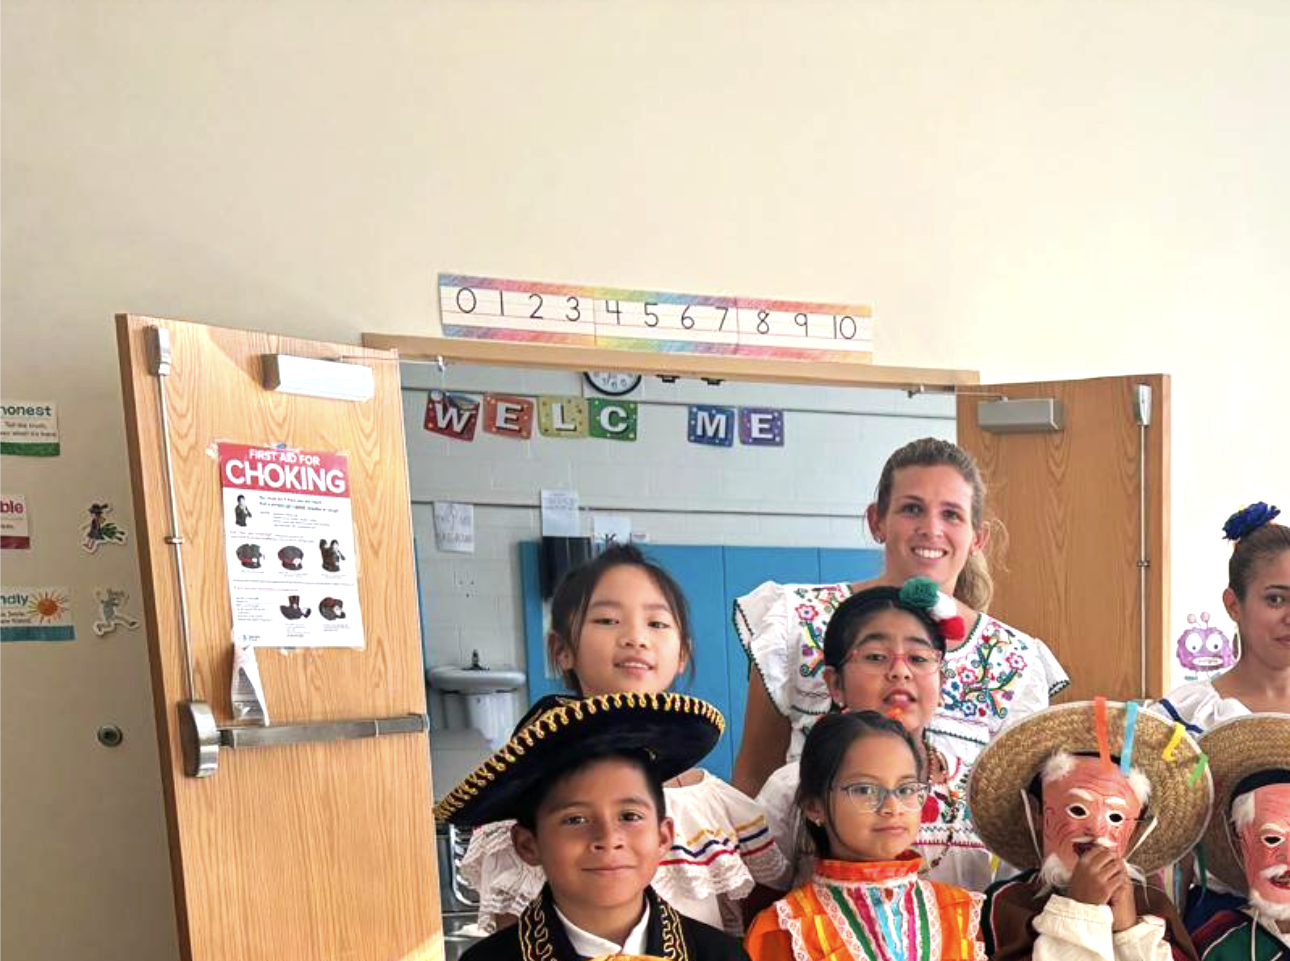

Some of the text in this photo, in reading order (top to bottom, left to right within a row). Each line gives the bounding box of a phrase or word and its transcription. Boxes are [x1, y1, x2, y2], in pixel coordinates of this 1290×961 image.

[456, 287, 857, 339] 0 1 2 3 4 5 6 7 8 9 10
[249, 449, 320, 466] FIRST AID FOR
[225, 459, 346, 493] CHOKING
